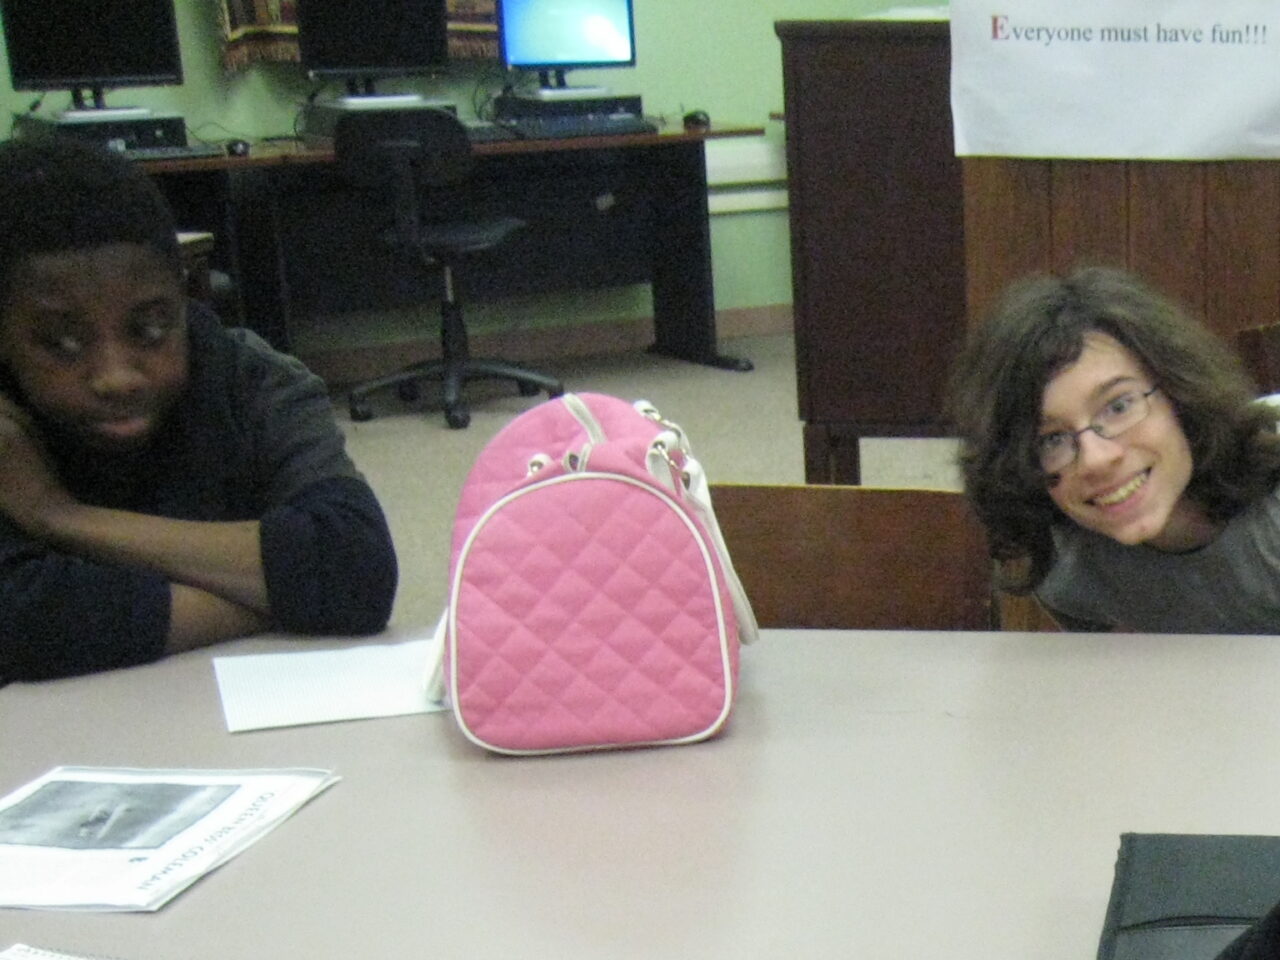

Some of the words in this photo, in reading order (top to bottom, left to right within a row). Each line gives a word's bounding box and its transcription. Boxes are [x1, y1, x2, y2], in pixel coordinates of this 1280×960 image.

[991, 15, 1093, 46] Everyone
[1100, 26, 1149, 43] must
[1156, 25, 1203, 44] have
[1210, 25, 1267, 45] fun!!!
